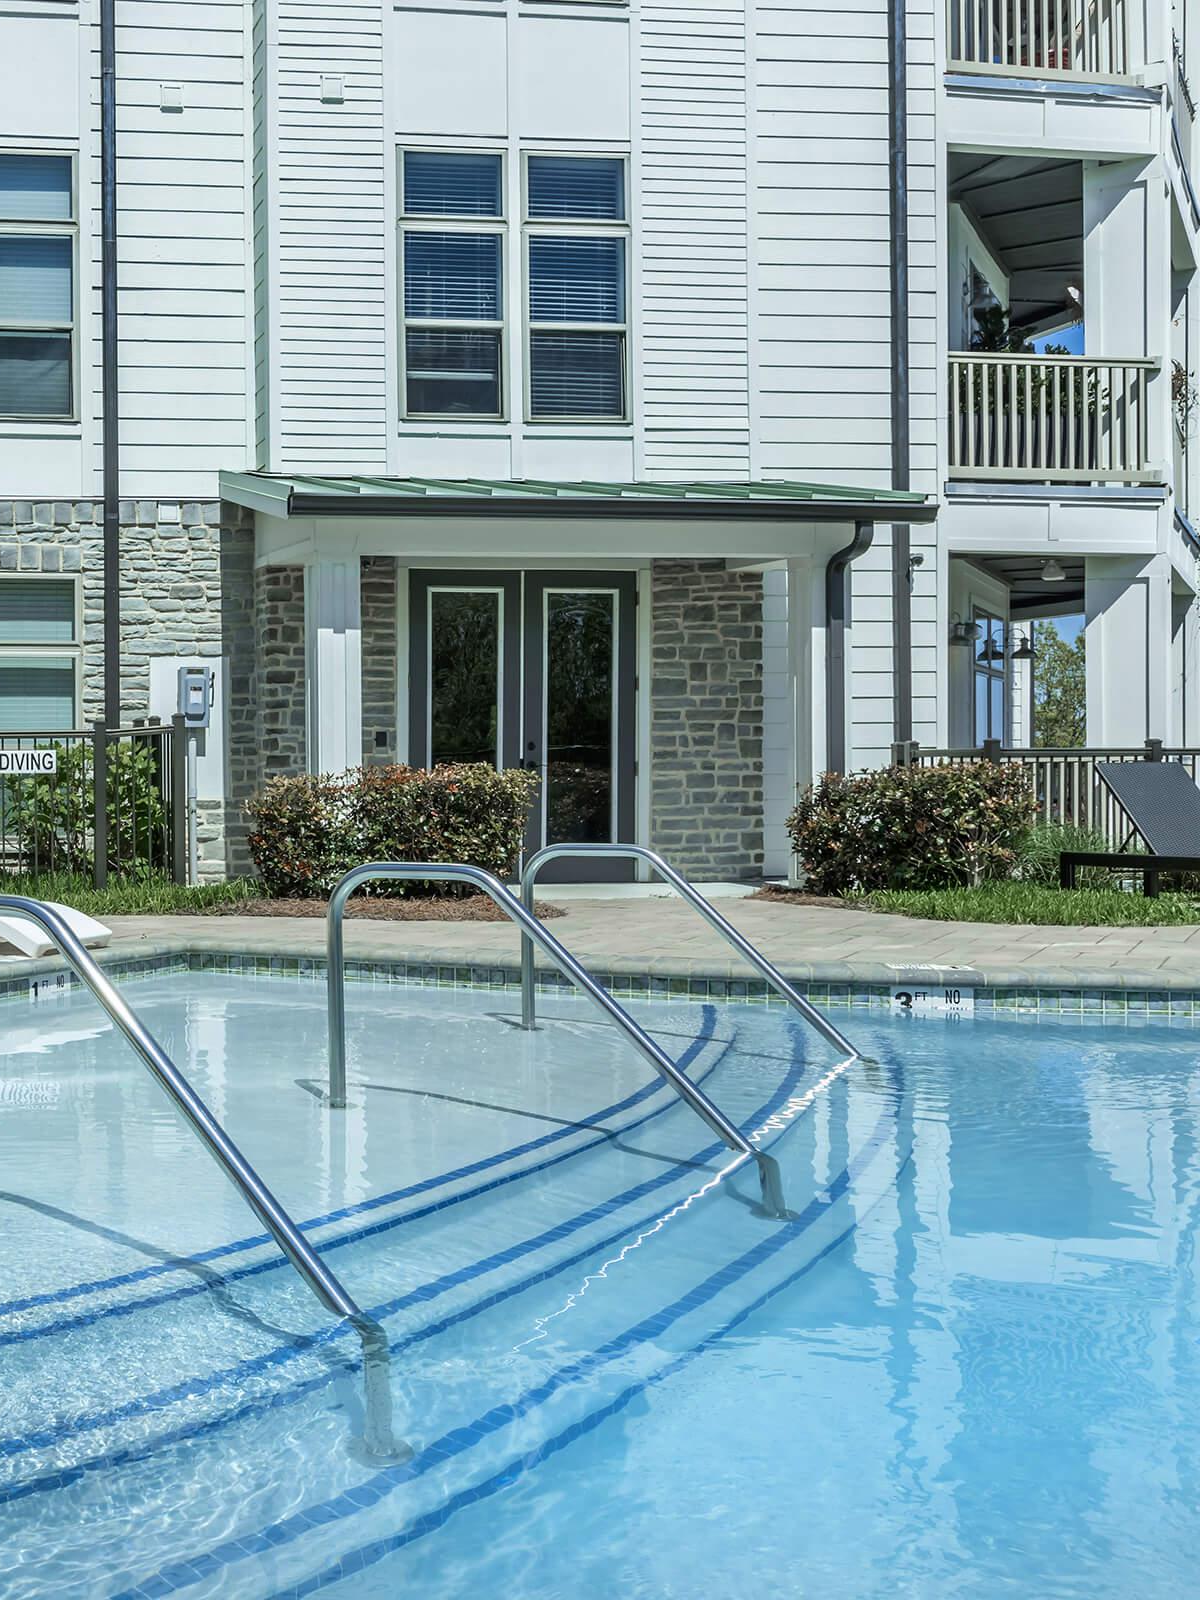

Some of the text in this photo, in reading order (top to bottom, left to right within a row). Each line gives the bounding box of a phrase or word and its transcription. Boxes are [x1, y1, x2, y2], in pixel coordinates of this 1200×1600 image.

[0, 753, 54, 770] DIVING
[32, 982, 38, 996] 1
[945, 989, 960, 1004] NO
[895, 991, 928, 1009] 3 FT
